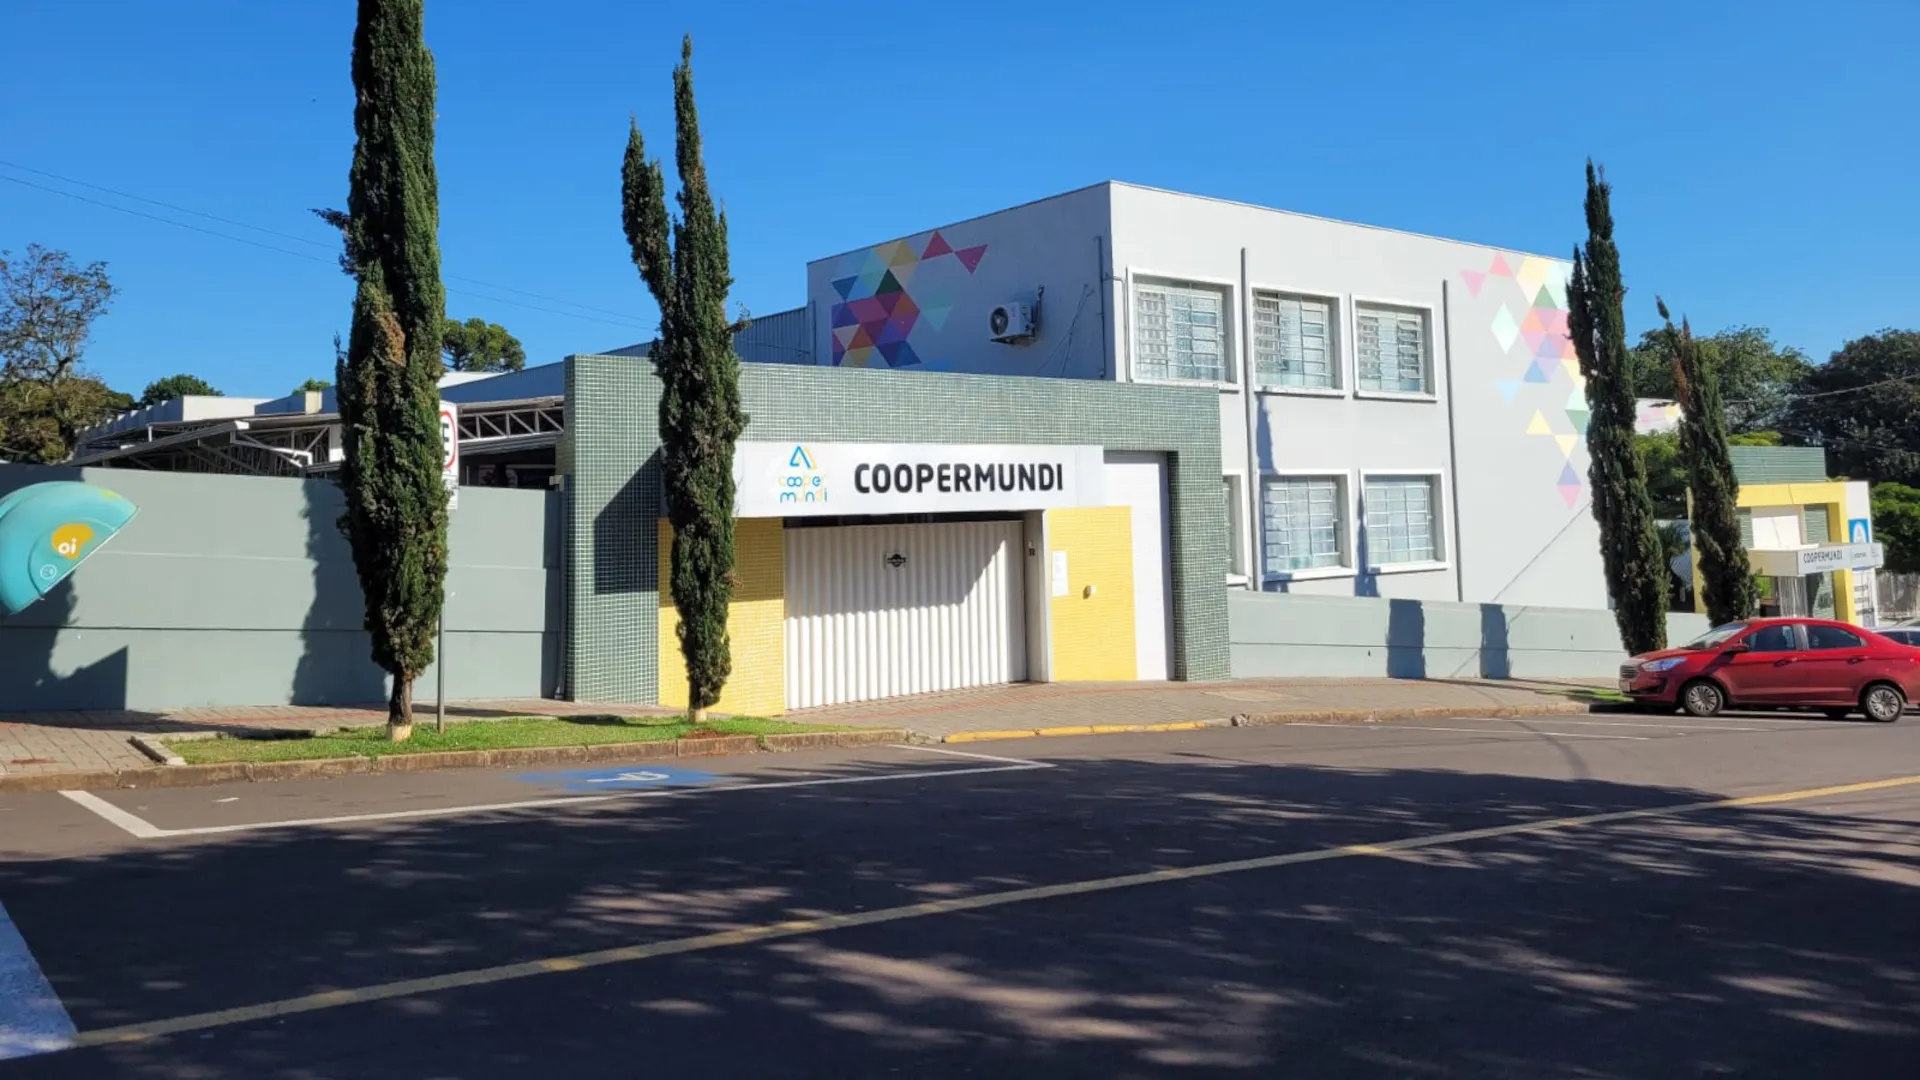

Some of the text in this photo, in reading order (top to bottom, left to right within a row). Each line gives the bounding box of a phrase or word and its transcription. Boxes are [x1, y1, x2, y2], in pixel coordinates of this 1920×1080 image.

[854, 463, 1063, 494] COOPERMUNDI
[58, 537, 77, 554] oi
[1803, 550, 1843, 564] COOPERMUNDI
